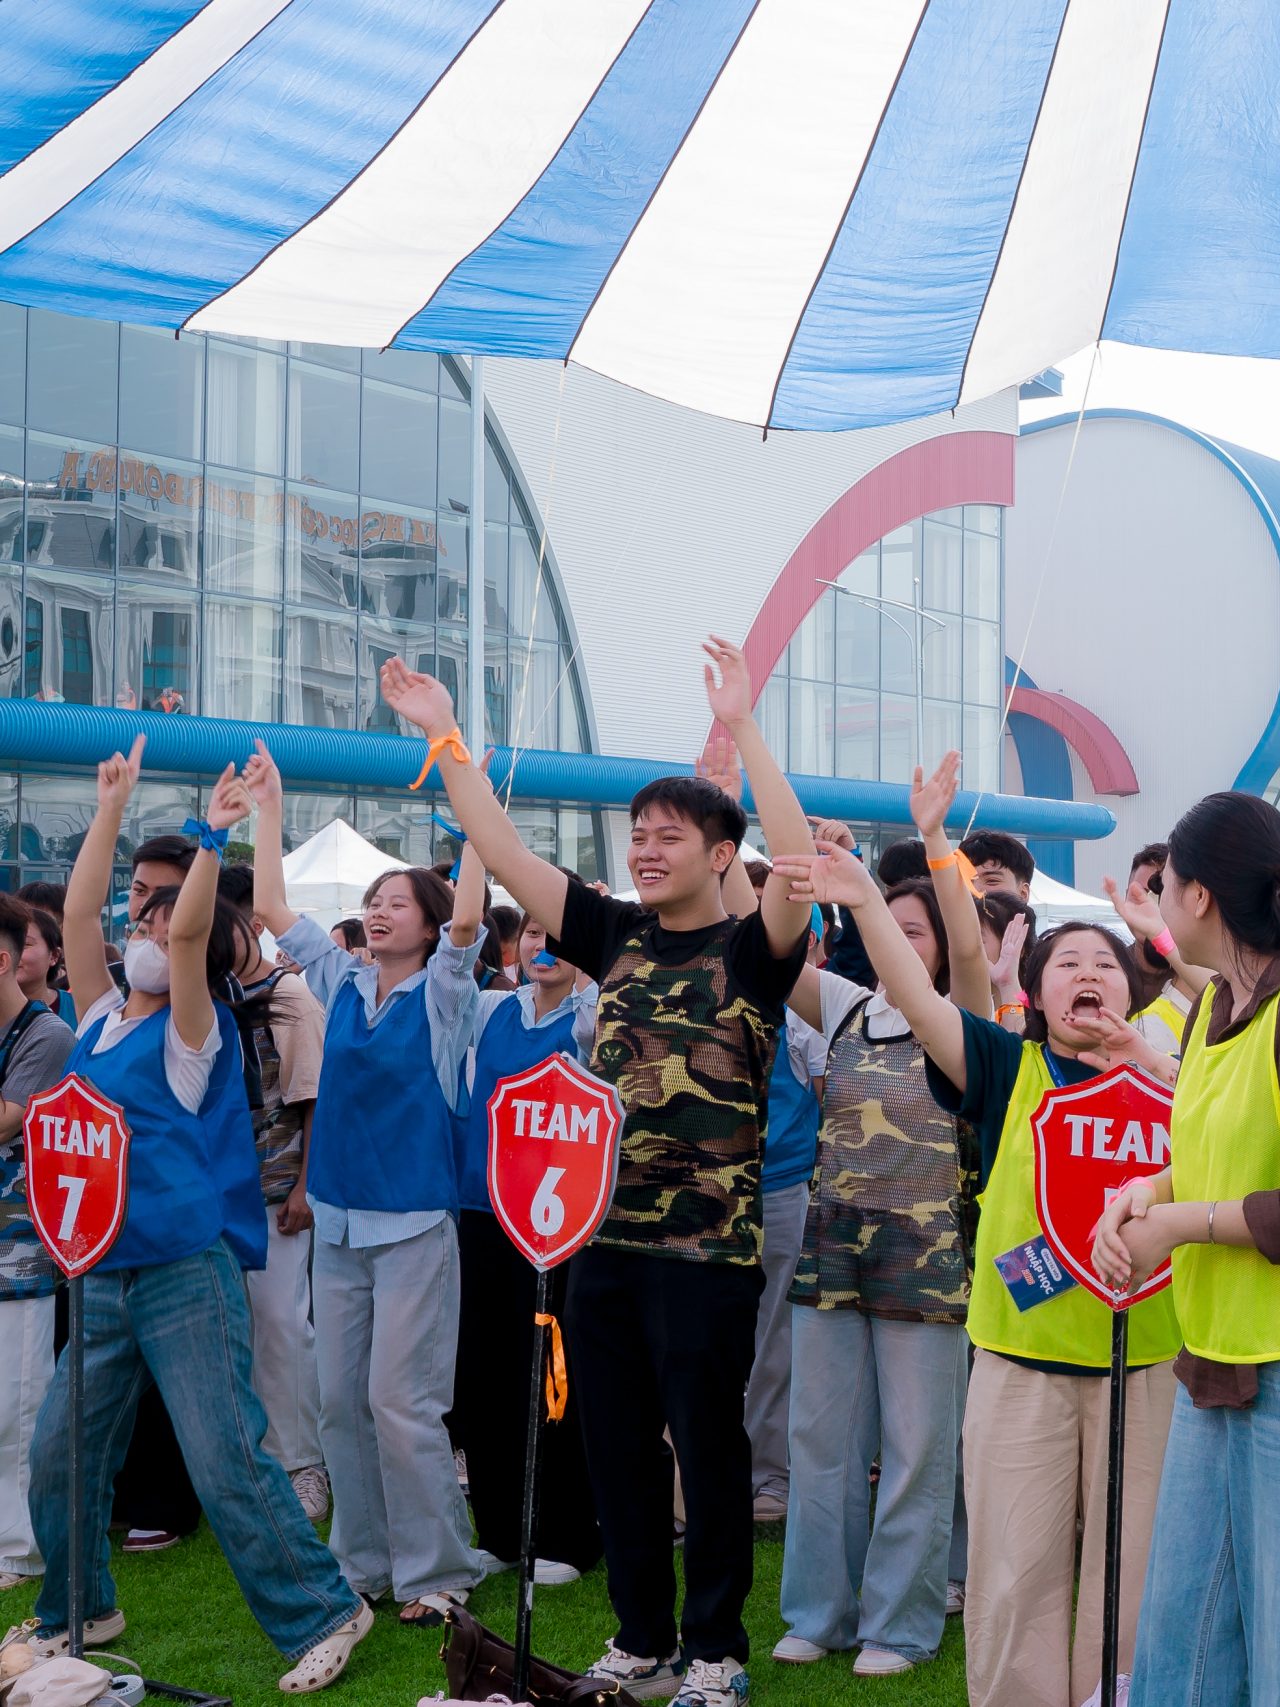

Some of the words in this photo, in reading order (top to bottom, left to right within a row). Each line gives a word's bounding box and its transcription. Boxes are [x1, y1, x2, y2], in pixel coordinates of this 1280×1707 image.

[39, 1114, 112, 1159] TEAM
[510, 1099, 600, 1144] TEAM
[57, 1174, 87, 1241] 7
[530, 1166, 567, 1237] 6
[1023, 1245, 1044, 1274] NHẬP
[1037, 1272, 1055, 1295] HỌC
